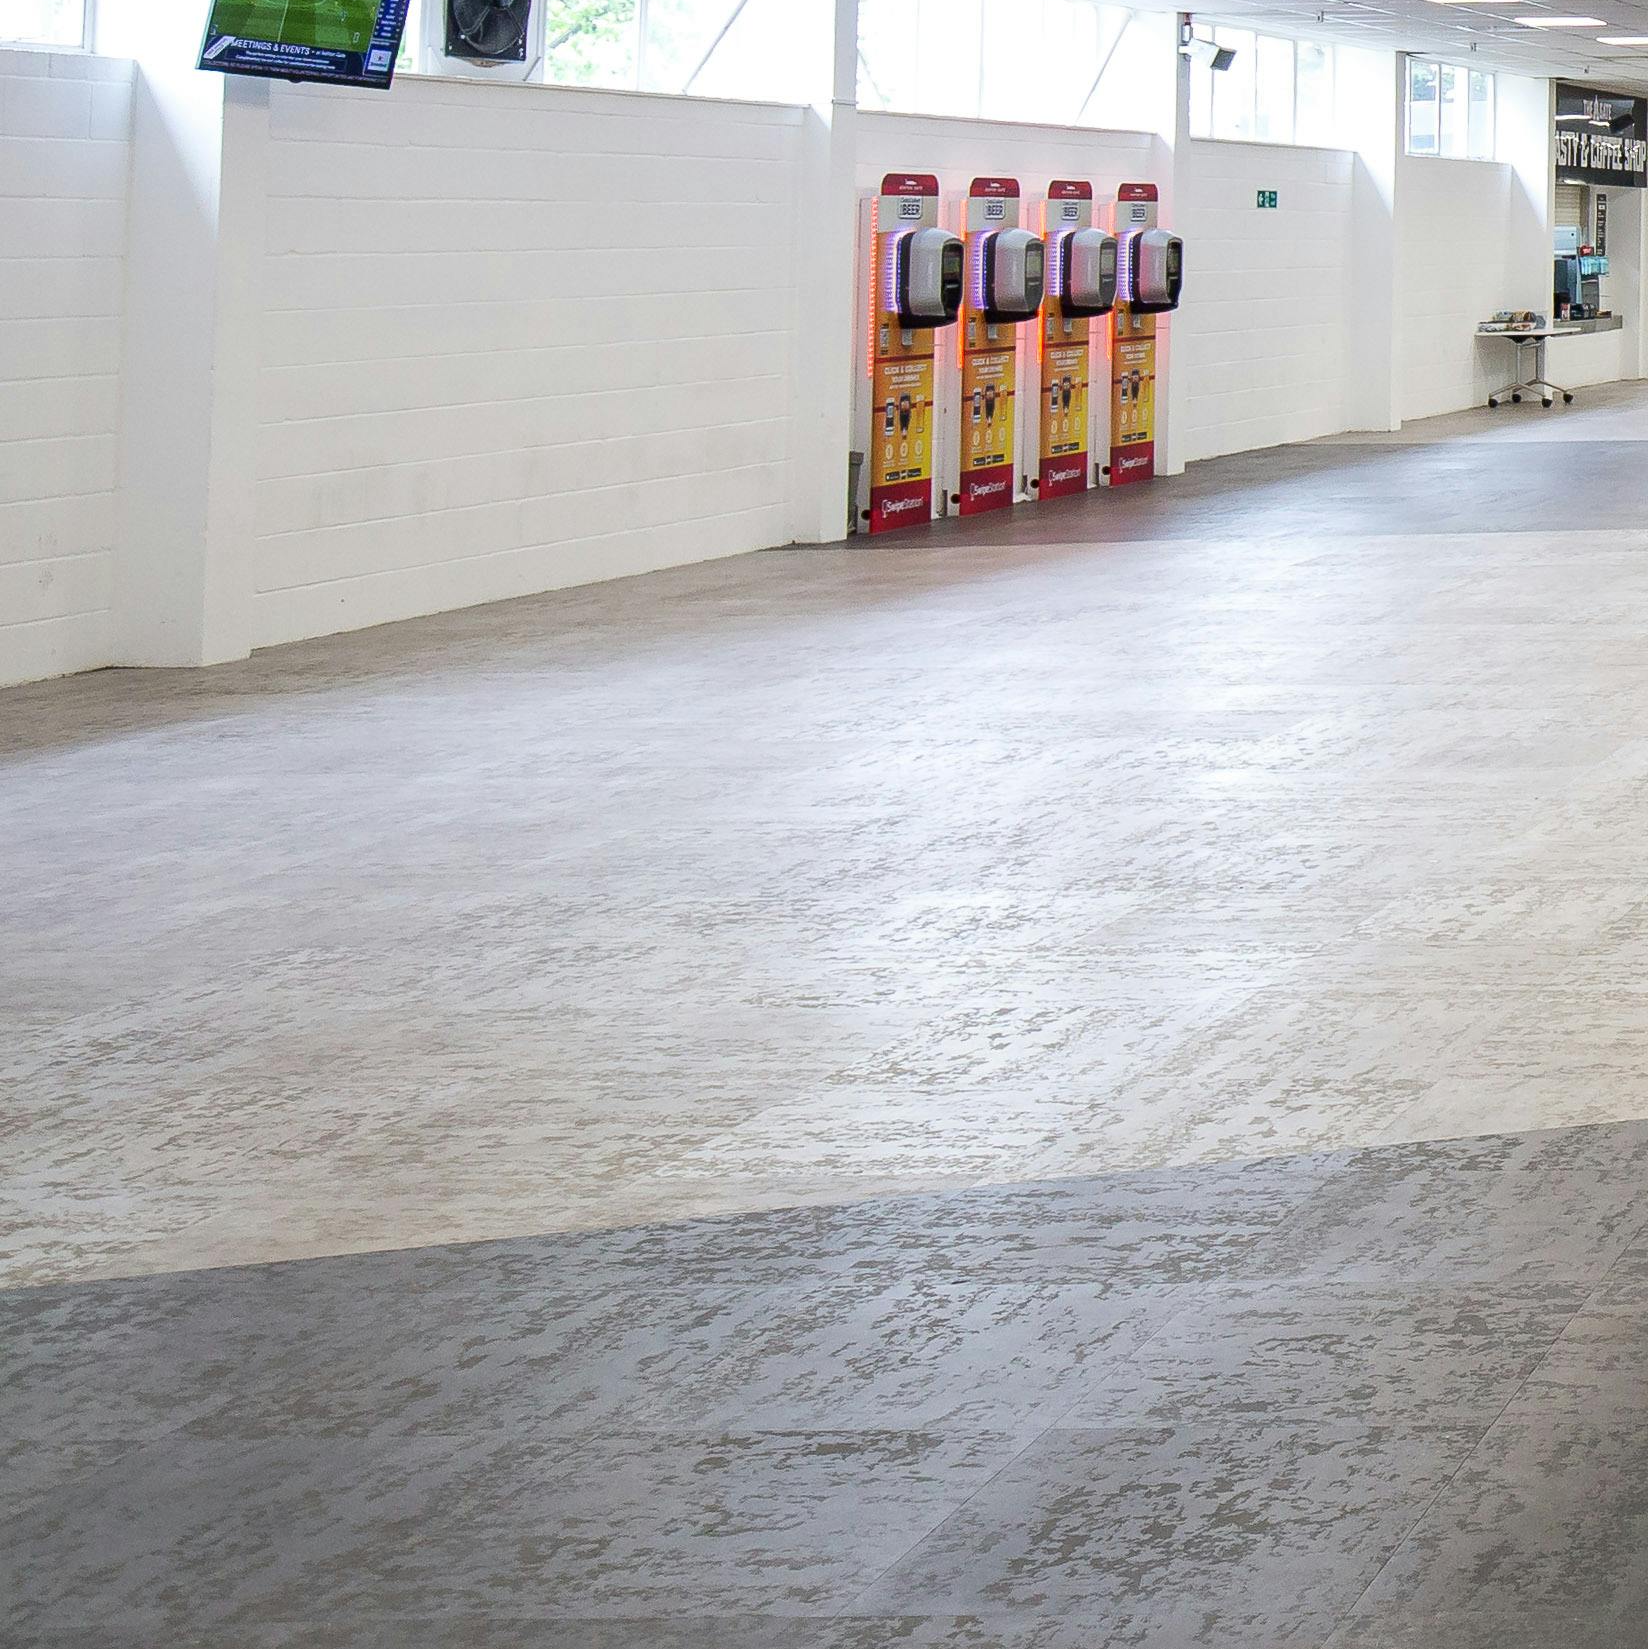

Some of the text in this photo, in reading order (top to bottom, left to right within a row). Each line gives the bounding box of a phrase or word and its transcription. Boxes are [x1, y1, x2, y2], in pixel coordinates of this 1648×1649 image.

[280, 44, 310, 55] EVENTS
[1556, 130, 1579, 167] ASTY
[1591, 134, 1623, 171] COFFEE
[1624, 138, 1646, 172] SHOP
